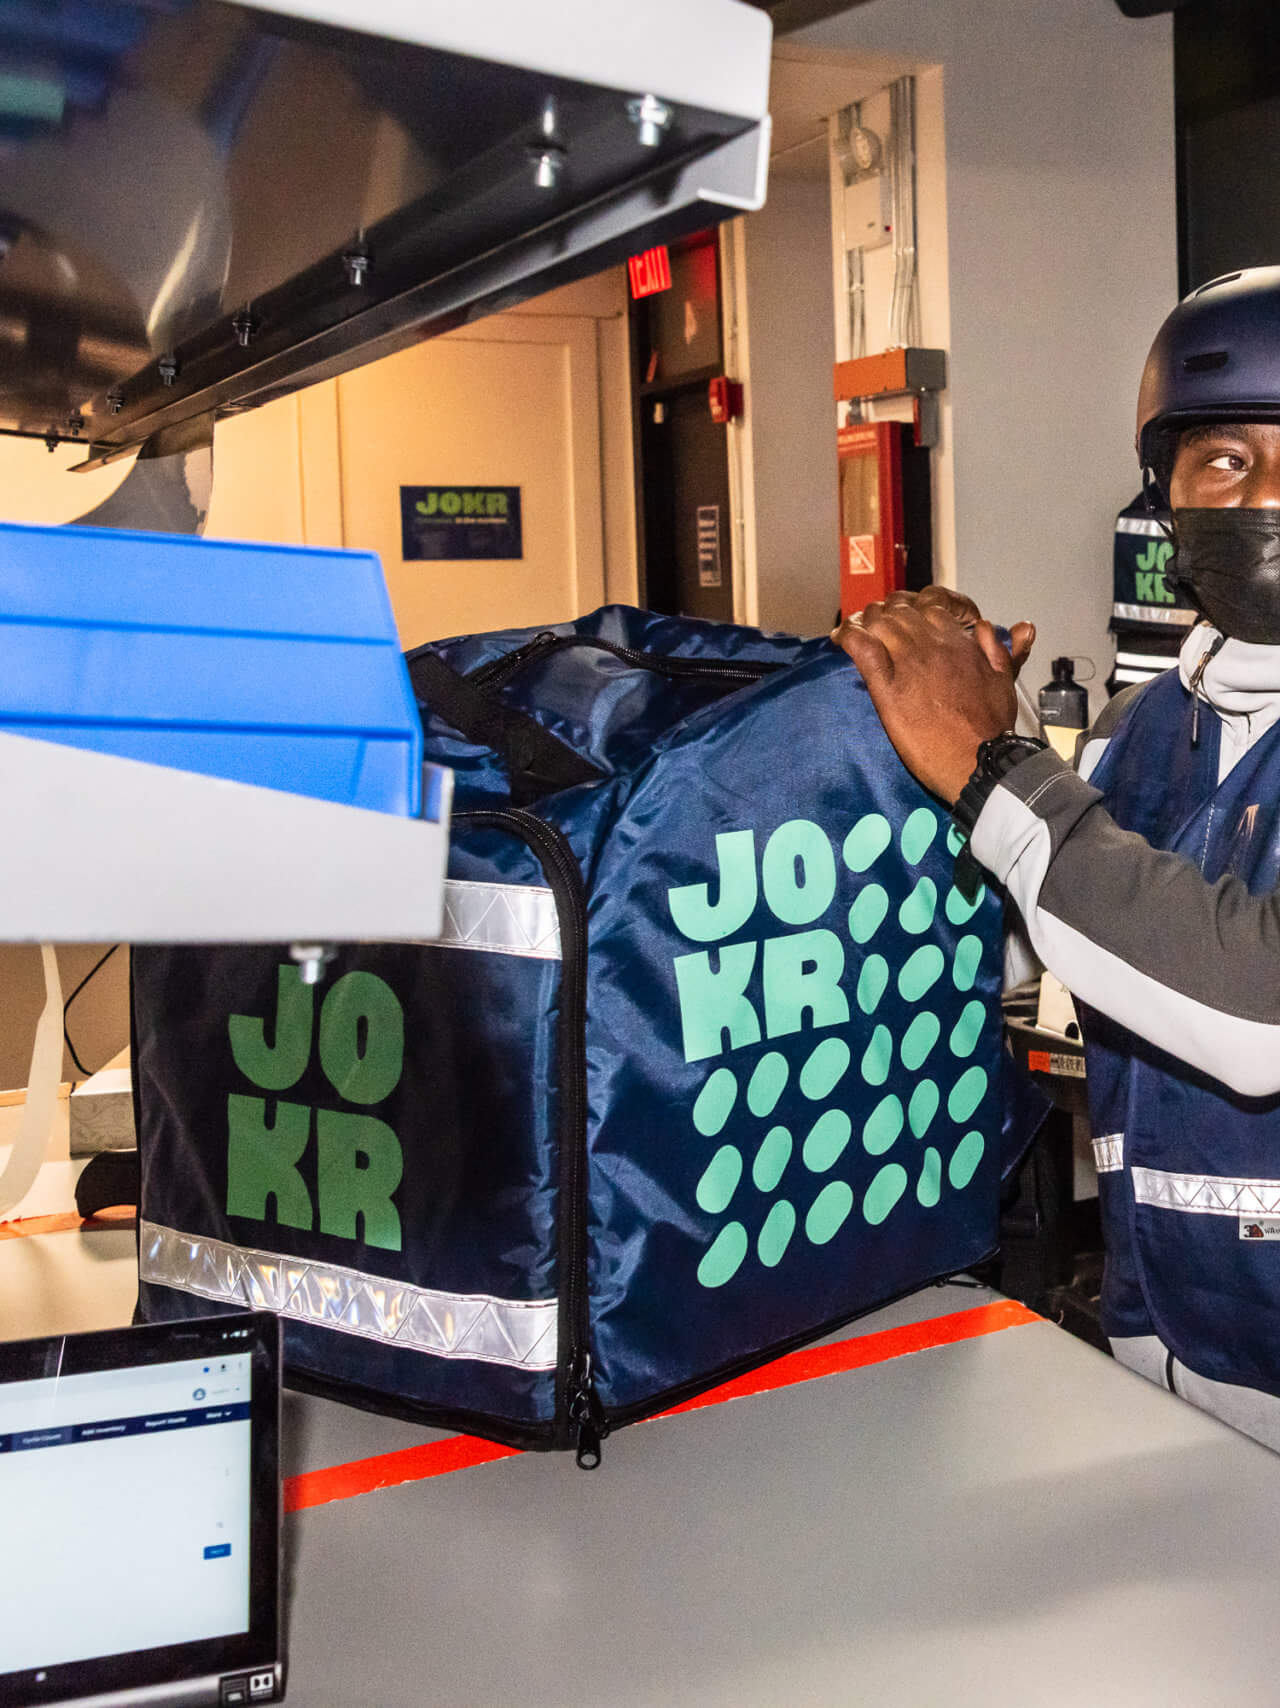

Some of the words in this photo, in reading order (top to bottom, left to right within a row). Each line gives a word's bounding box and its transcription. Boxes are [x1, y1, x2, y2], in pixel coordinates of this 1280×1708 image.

[415, 490, 508, 516] JOKR
[668, 819, 837, 942] JO
[228, 963, 404, 1104] JO
[673, 928, 850, 1063] KR
[226, 1093, 404, 1252] KR
